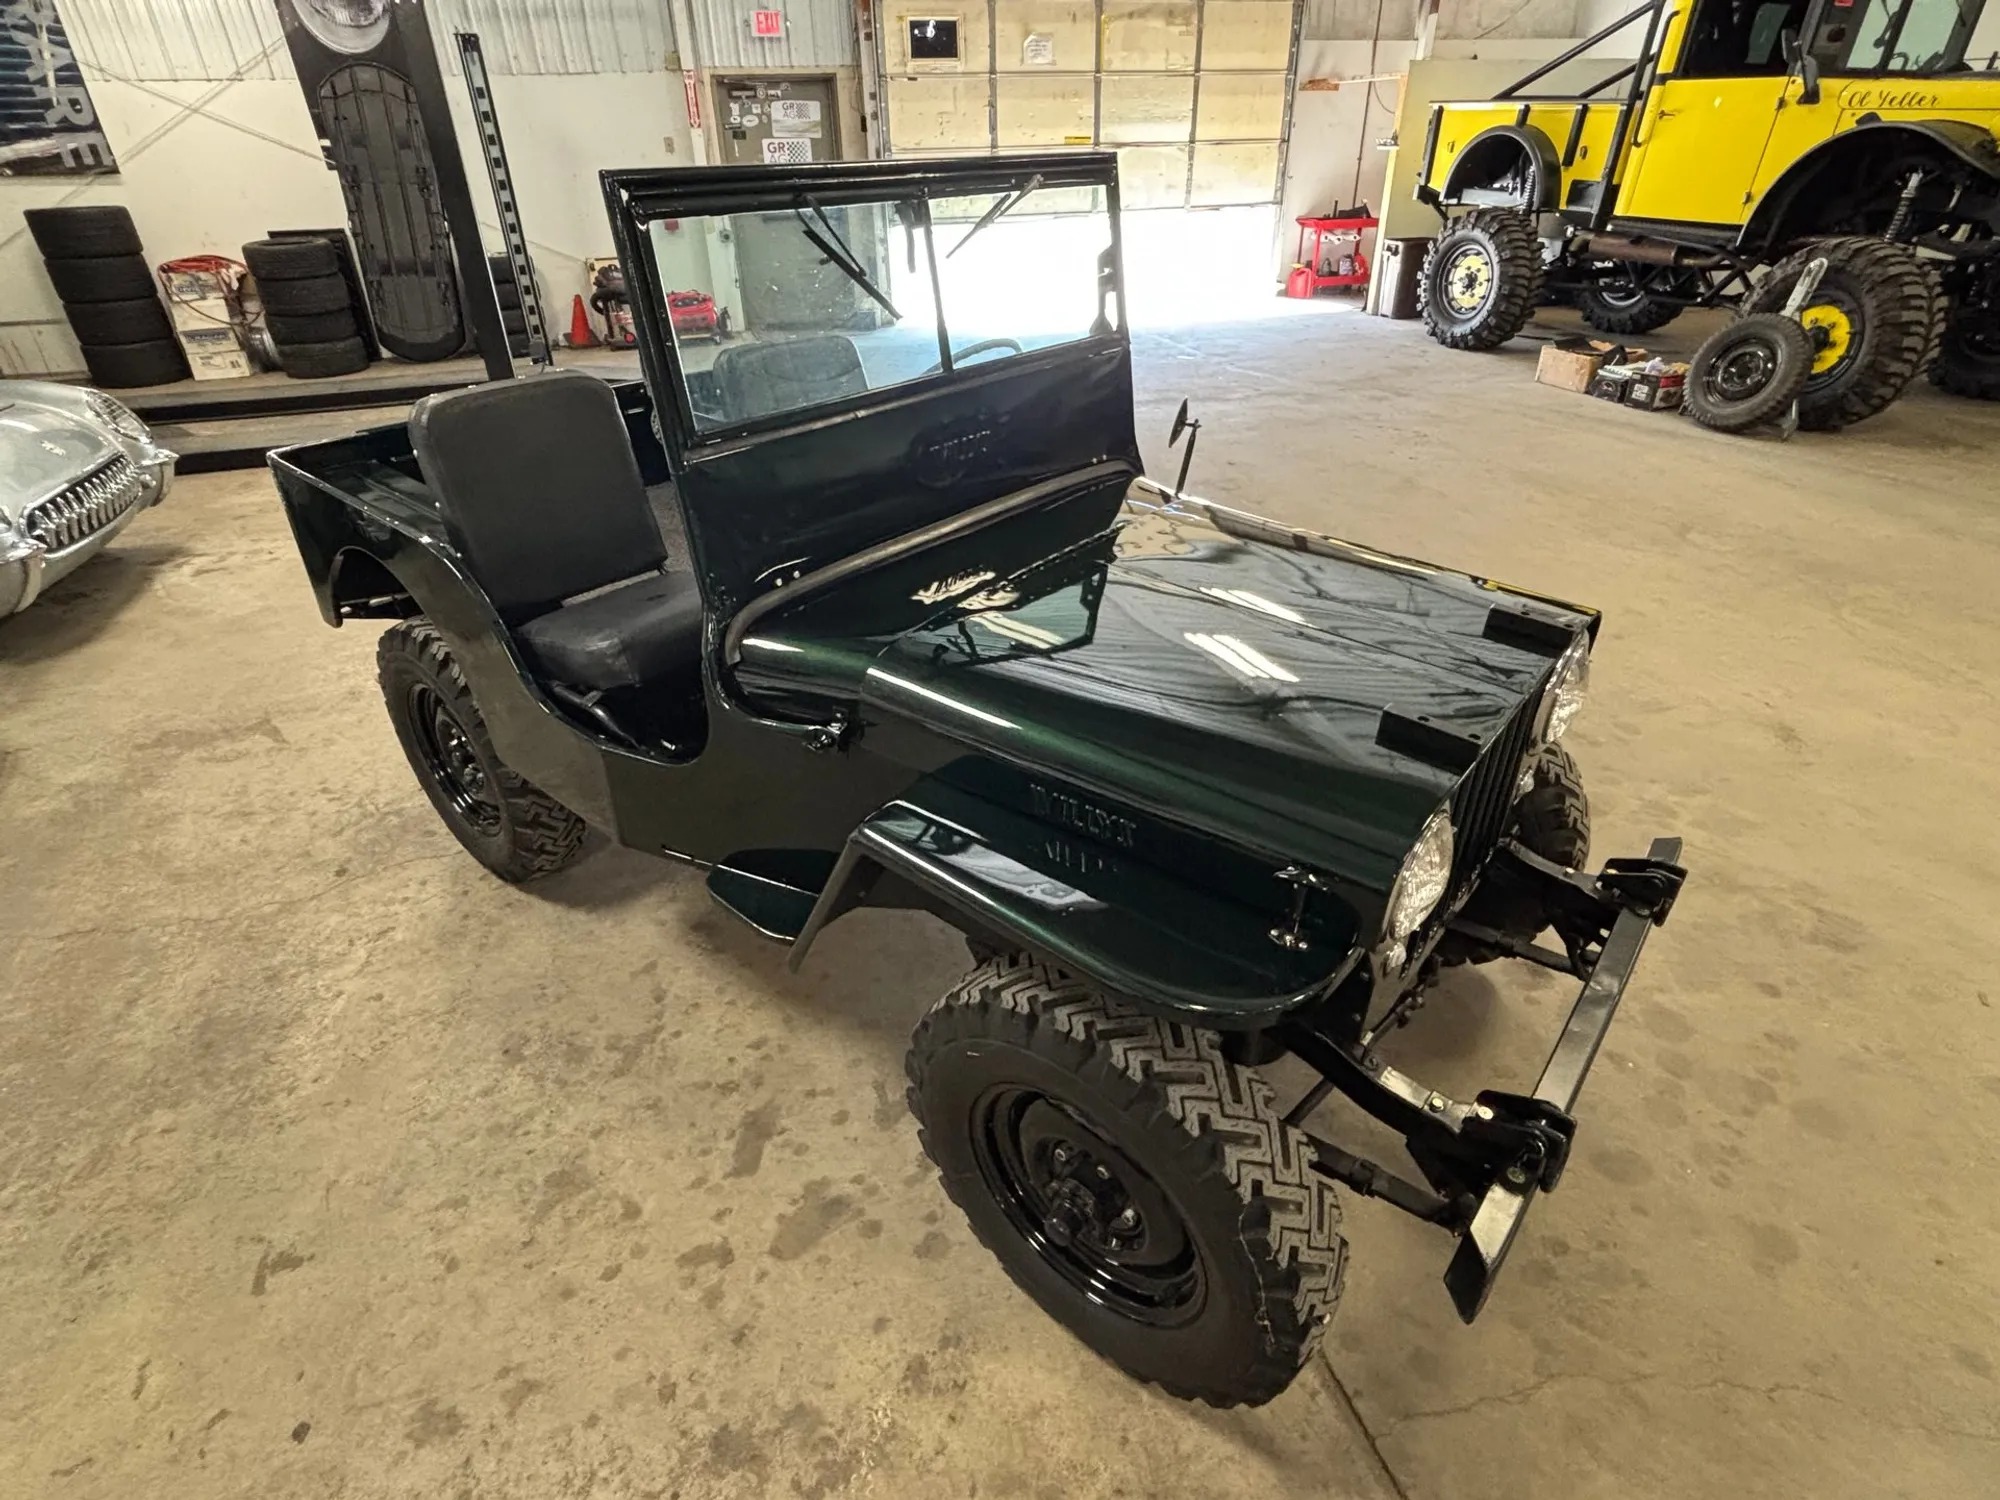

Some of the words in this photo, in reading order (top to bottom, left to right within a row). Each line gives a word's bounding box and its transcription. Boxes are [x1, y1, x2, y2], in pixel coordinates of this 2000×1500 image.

[756, 11, 780, 34] EXIT
[782, 102, 795, 111] GR
[1847, 90, 1872, 108] Ol
[1878, 89, 1939, 108] Yeller
[767, 141, 786, 154] GR
